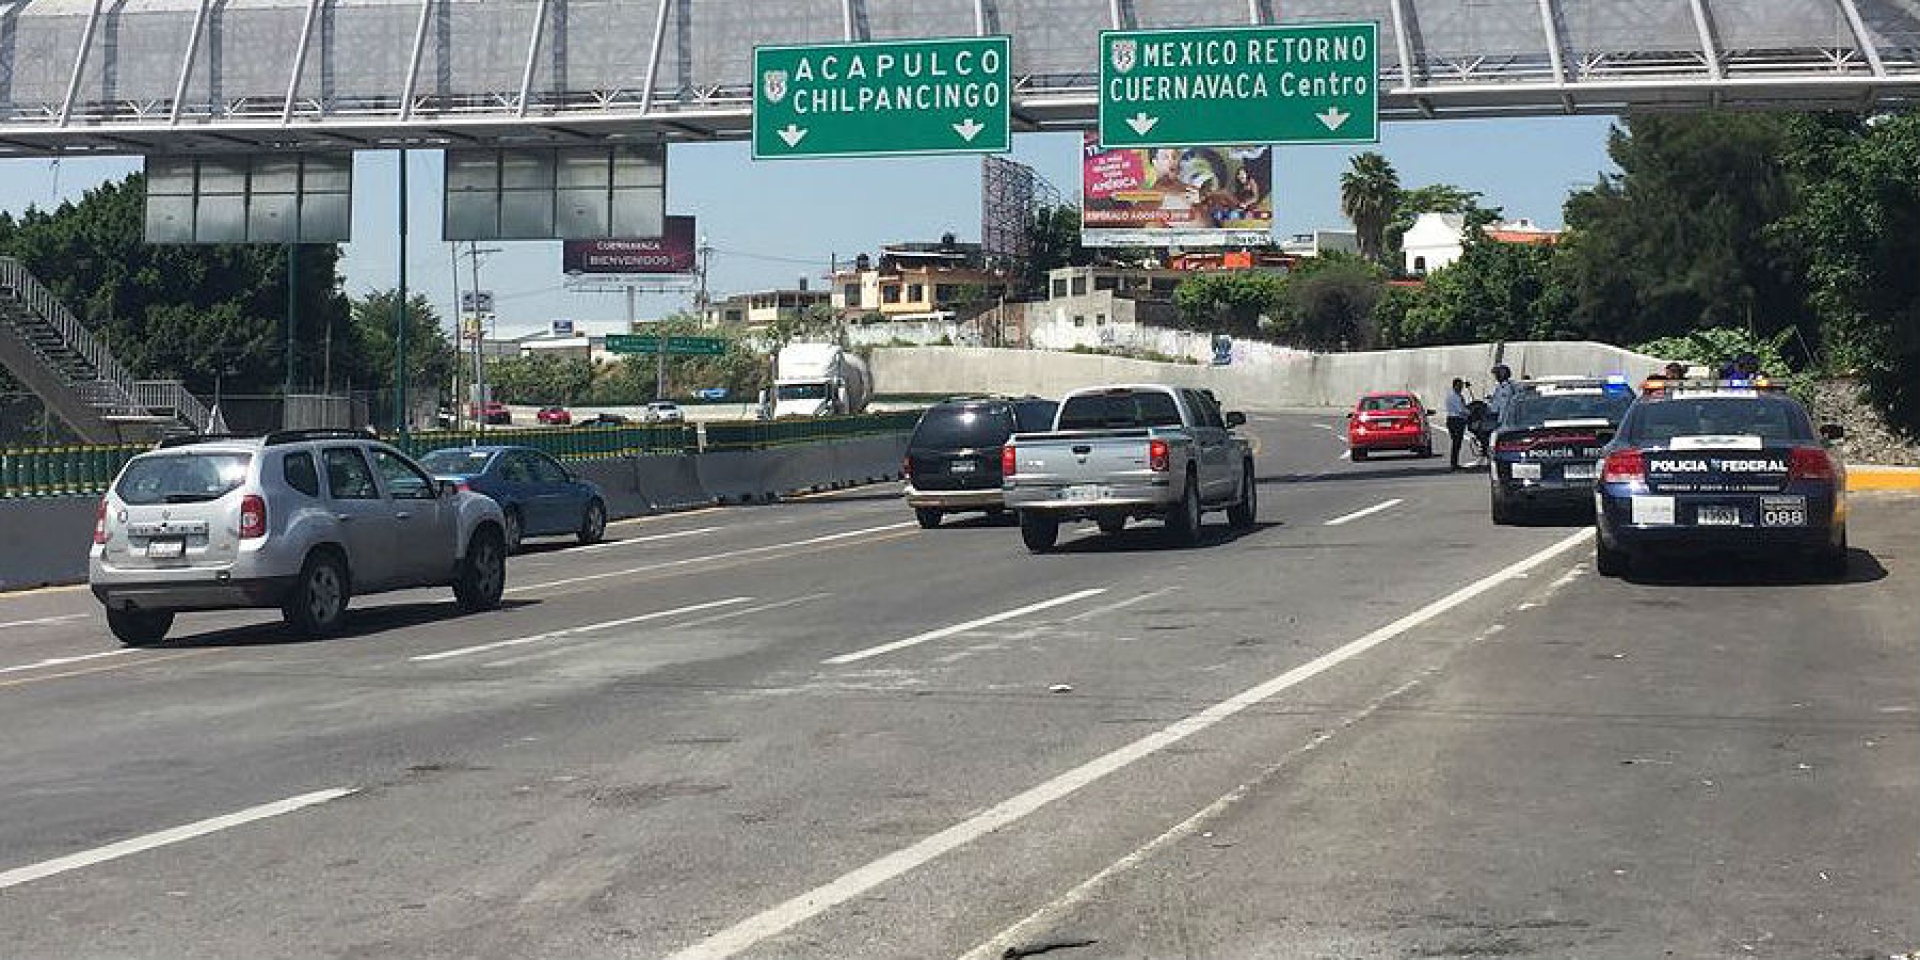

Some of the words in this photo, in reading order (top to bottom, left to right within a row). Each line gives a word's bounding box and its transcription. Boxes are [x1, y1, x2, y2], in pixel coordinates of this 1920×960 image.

[795, 48, 1000, 82] ACAPULCO
[1143, 40, 1237, 68] MEXICO
[1247, 35, 1366, 65] RETORNO
[794, 82, 1000, 114] CHILPANCINGO
[1110, 72, 1268, 102] CUERNAVACA
[1280, 71, 1367, 98] Centro
[1721, 460, 1789, 472] FEDERAL
[1764, 511, 1804, 526] 088
